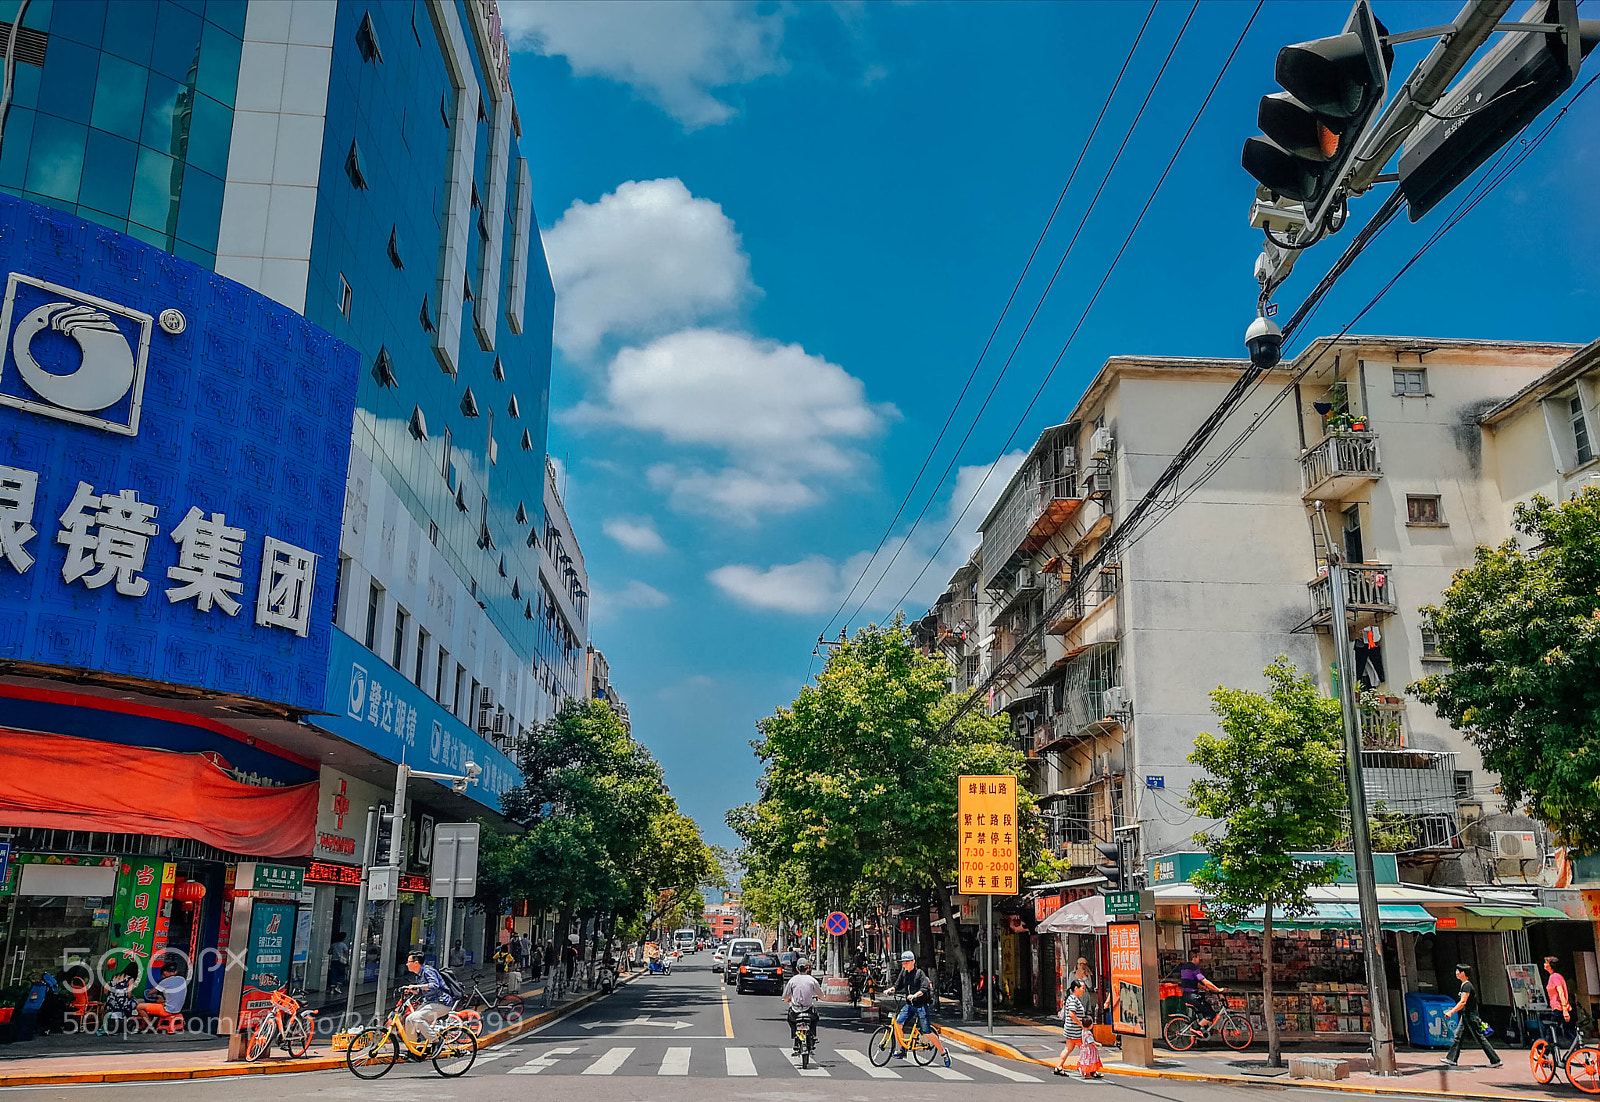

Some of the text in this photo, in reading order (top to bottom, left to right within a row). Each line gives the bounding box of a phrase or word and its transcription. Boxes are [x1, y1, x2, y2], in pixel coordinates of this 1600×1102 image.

[968, 782, 1007, 795] 蜂巢山路
[964, 813, 1012, 826] 繁忙路段
[964, 832, 1012, 845] 严禁停车
[964, 875, 1013, 888] 停车重罚
